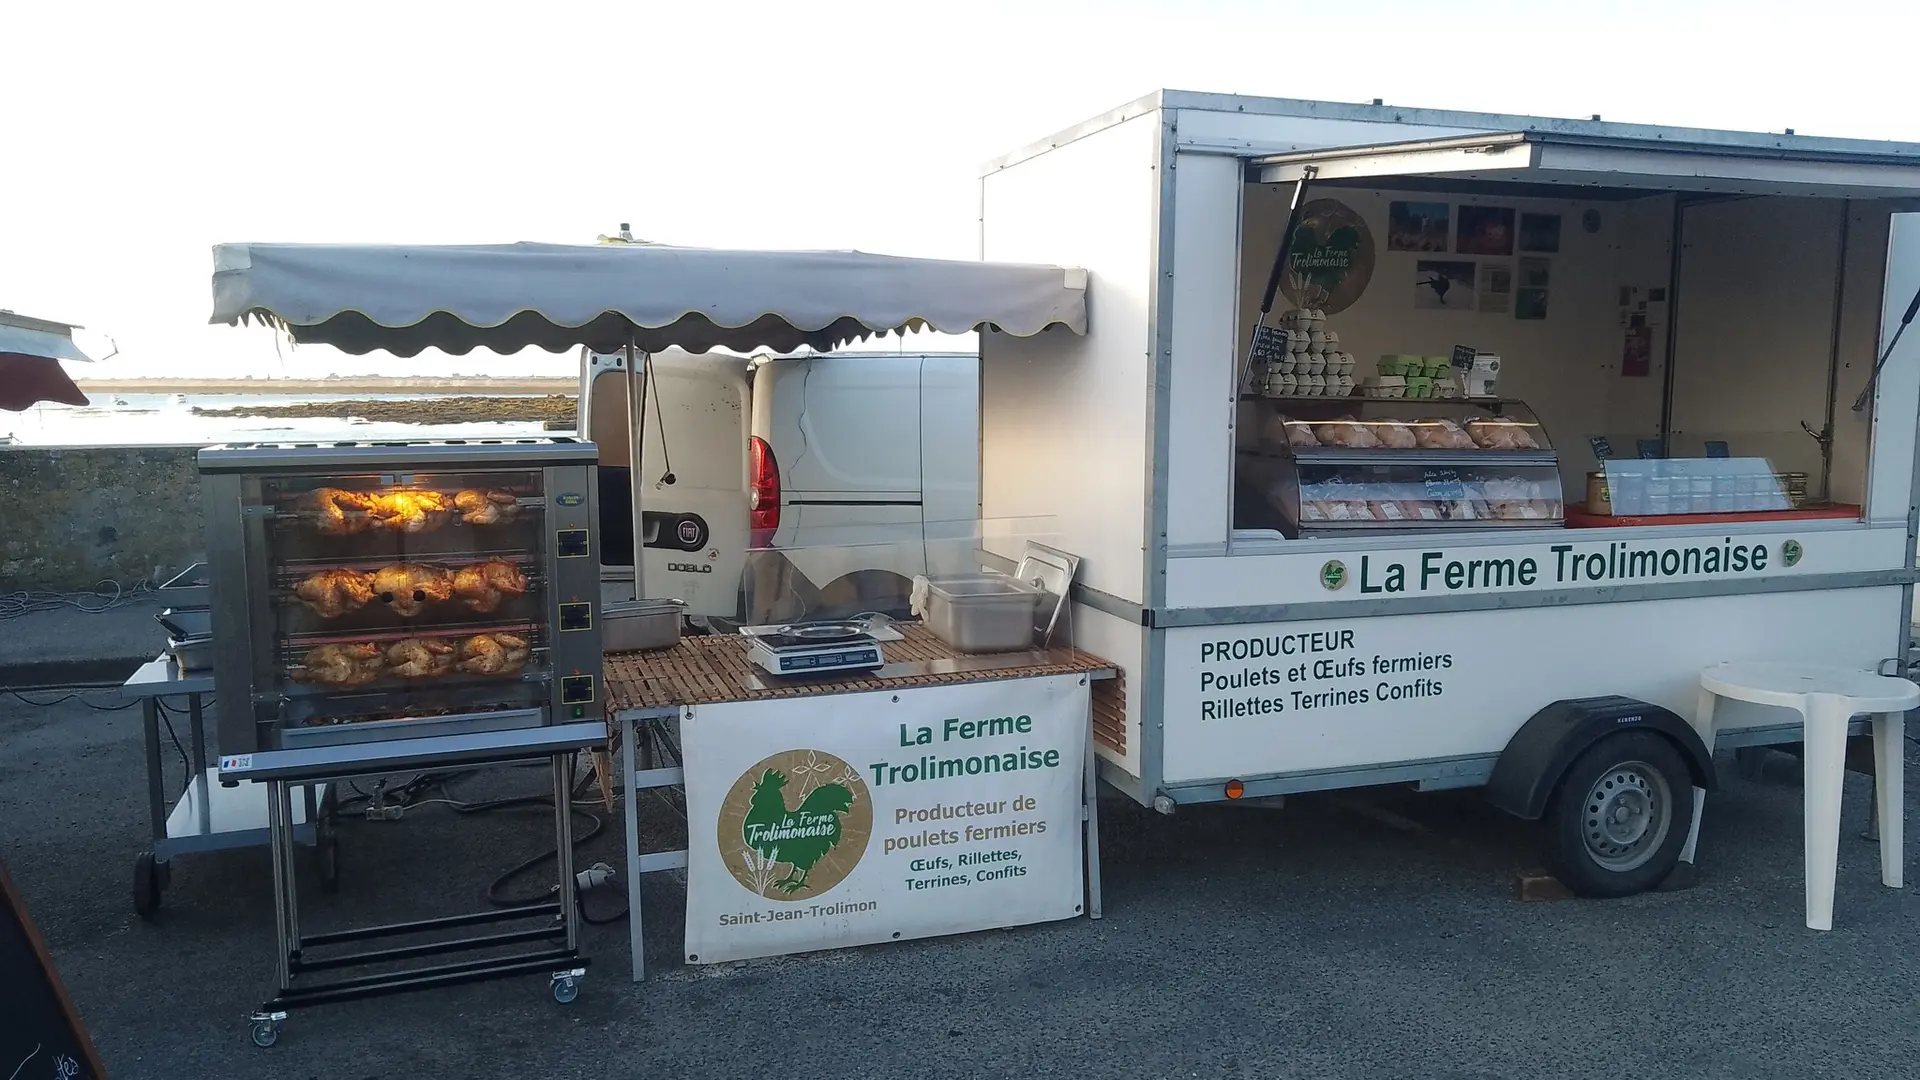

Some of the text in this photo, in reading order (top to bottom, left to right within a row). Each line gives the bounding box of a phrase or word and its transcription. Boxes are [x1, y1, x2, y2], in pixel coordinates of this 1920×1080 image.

[1292, 252, 1349, 269] Trolimonaise
[1313, 246, 1348, 258] La Ferme
[682, 527, 696, 538] FIAT
[668, 563, 712, 574] DOBLO
[1360, 537, 1768, 594] La Ferme Trolimonaise
[1201, 629, 1355, 663] PRODUCTEUR
[1201, 652, 1453, 692] Poulets et Œufs fermiers
[1201, 678, 1443, 720] Rillettes Terrines Confits
[900, 714, 1032, 747] La Ferme
[869, 746, 1060, 786] Trolimonaise
[781, 811, 835, 828] La Ferme
[895, 795, 1036, 824] Producteur de
[746, 822, 836, 846] Trolimonaise
[884, 820, 1047, 855] poulets fermiers
[910, 849, 1022, 872] Œufs, Rillettes,
[905, 865, 1027, 891] Terrines, Confits
[719, 900, 877, 926] Saint-Jean-Trolimon
